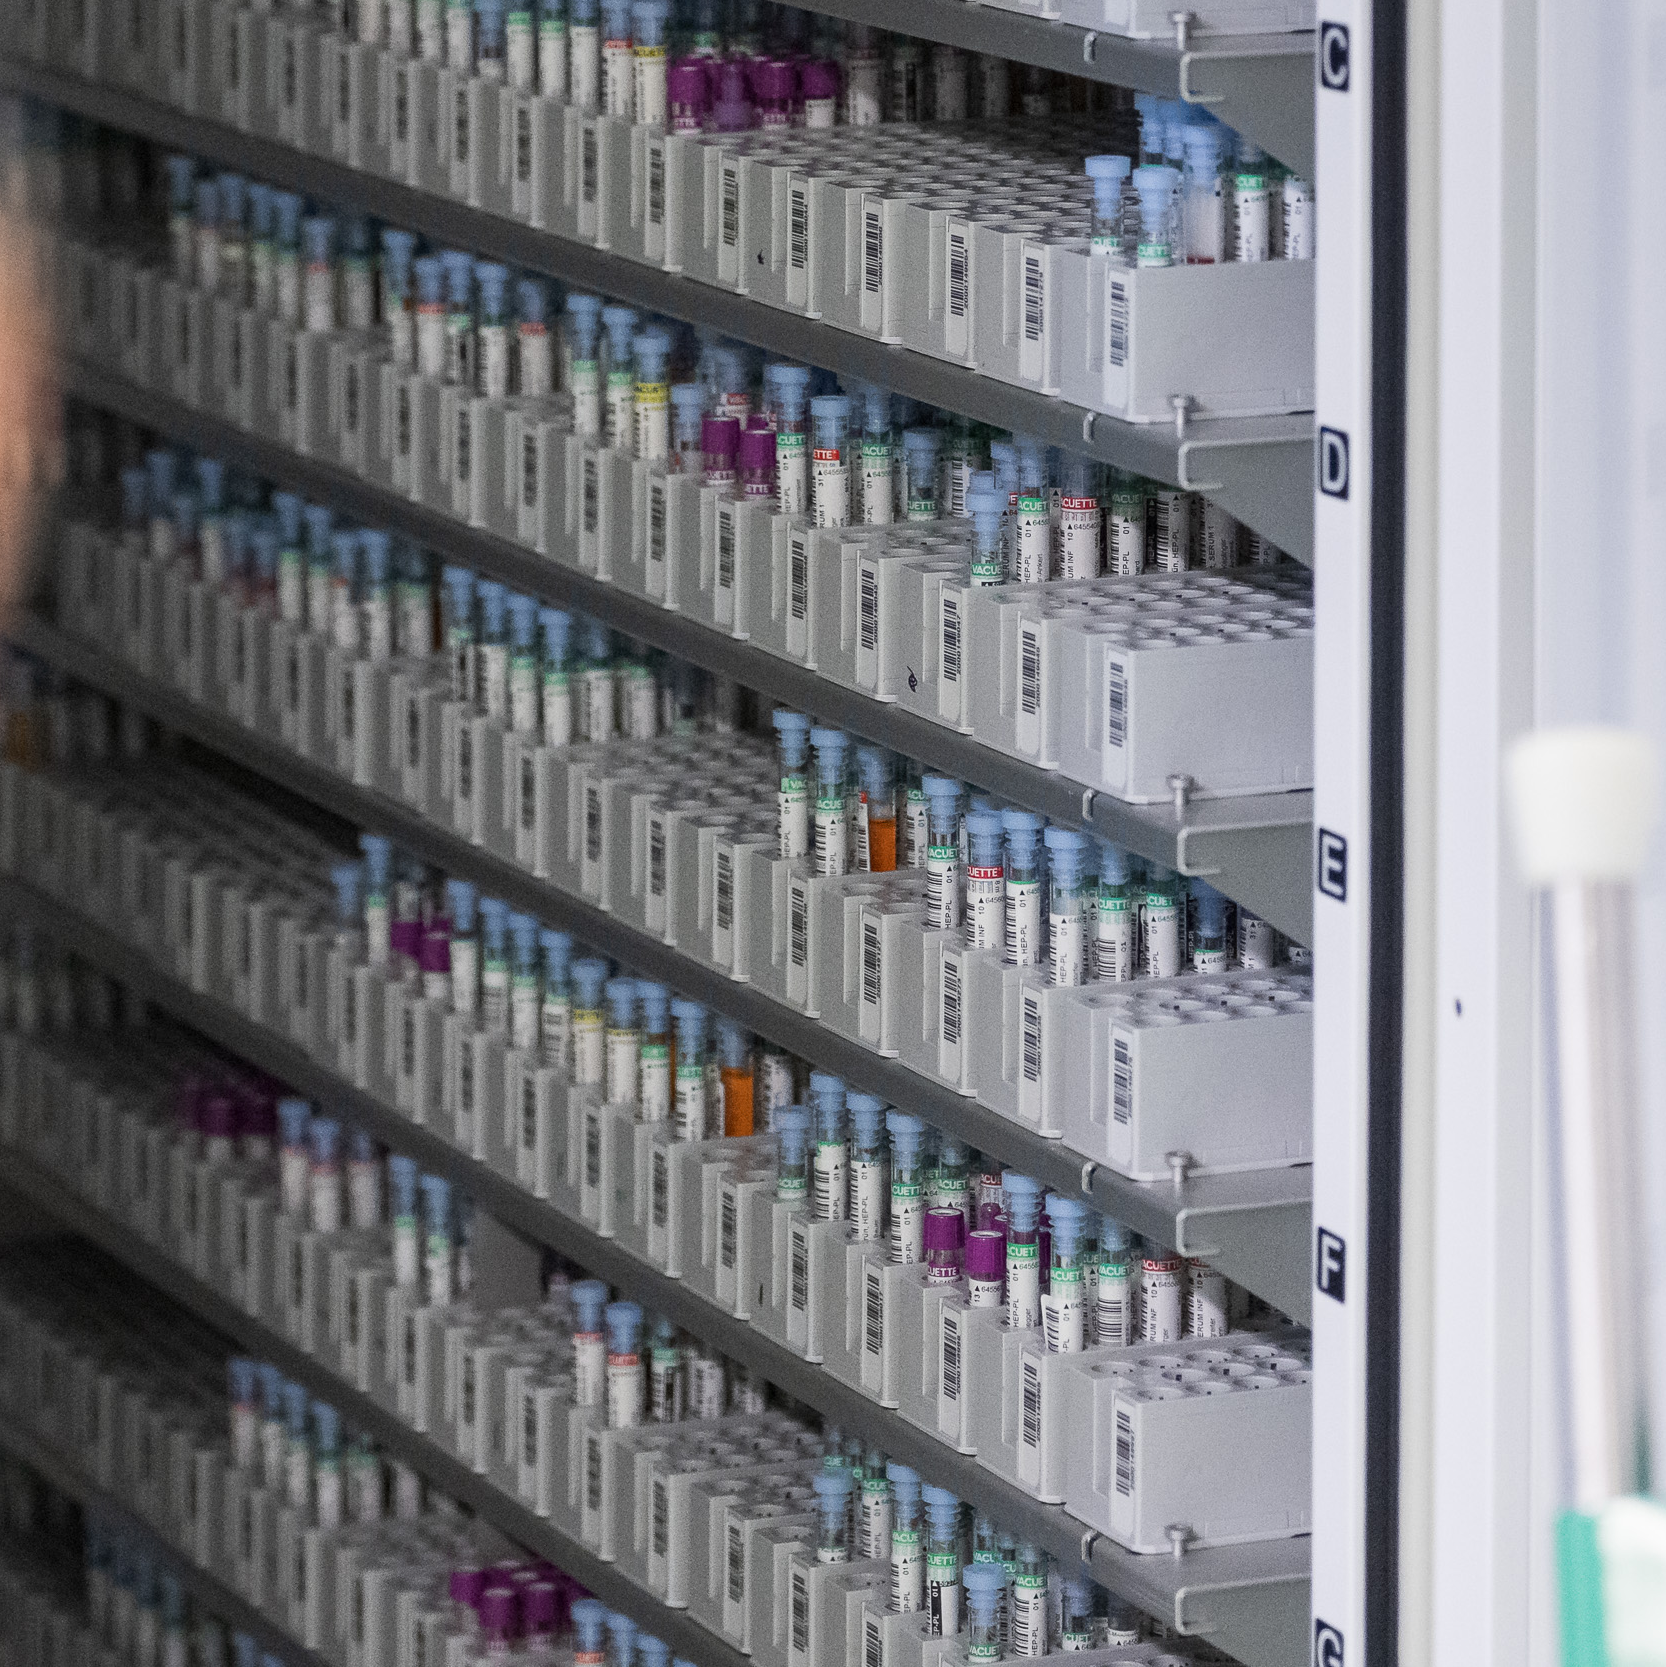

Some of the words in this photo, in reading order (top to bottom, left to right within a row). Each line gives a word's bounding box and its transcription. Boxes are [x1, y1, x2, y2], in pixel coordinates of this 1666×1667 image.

[1322, 25, 1348, 88] C
[1322, 429, 1347, 495] D
[1321, 831, 1345, 897] E
[1321, 1231, 1344, 1291] F
